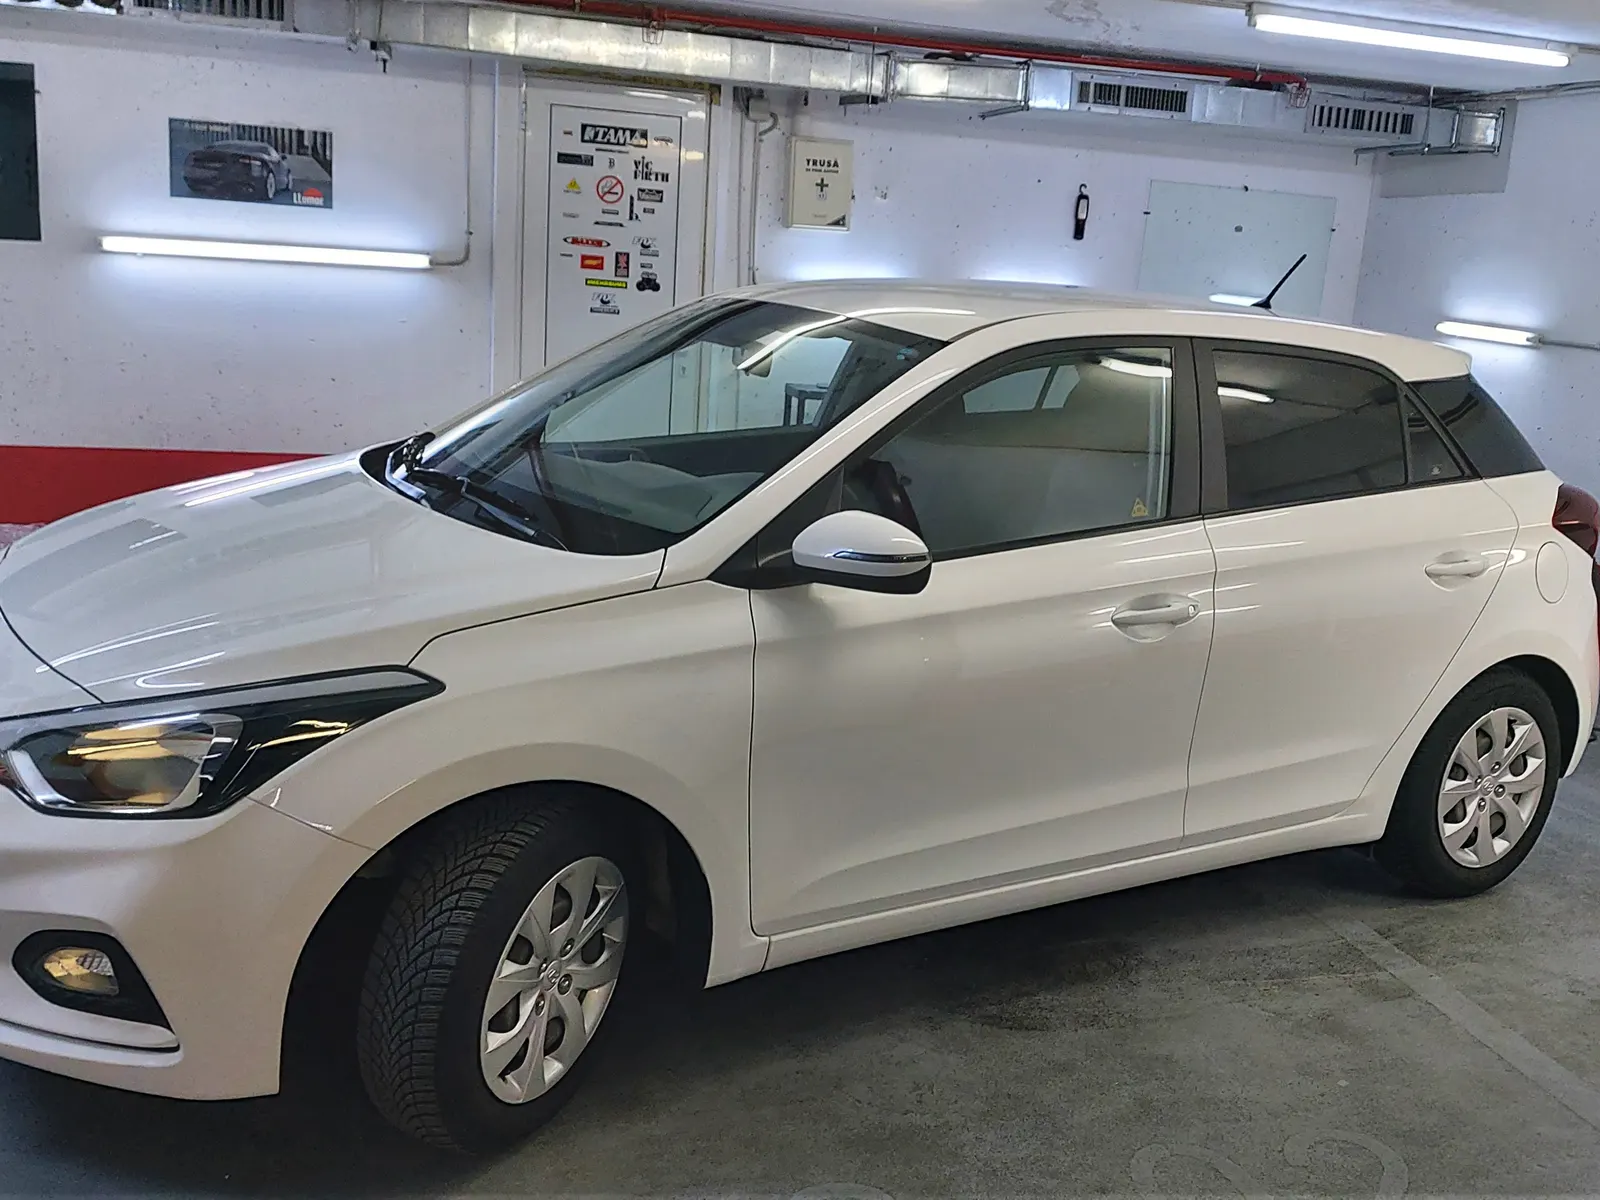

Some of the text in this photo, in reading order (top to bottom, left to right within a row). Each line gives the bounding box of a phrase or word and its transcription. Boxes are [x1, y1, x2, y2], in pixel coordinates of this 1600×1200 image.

[596, 127, 645, 146] TAMA
[633, 156, 653, 171] VIC
[633, 170, 670, 182] FIRTH
